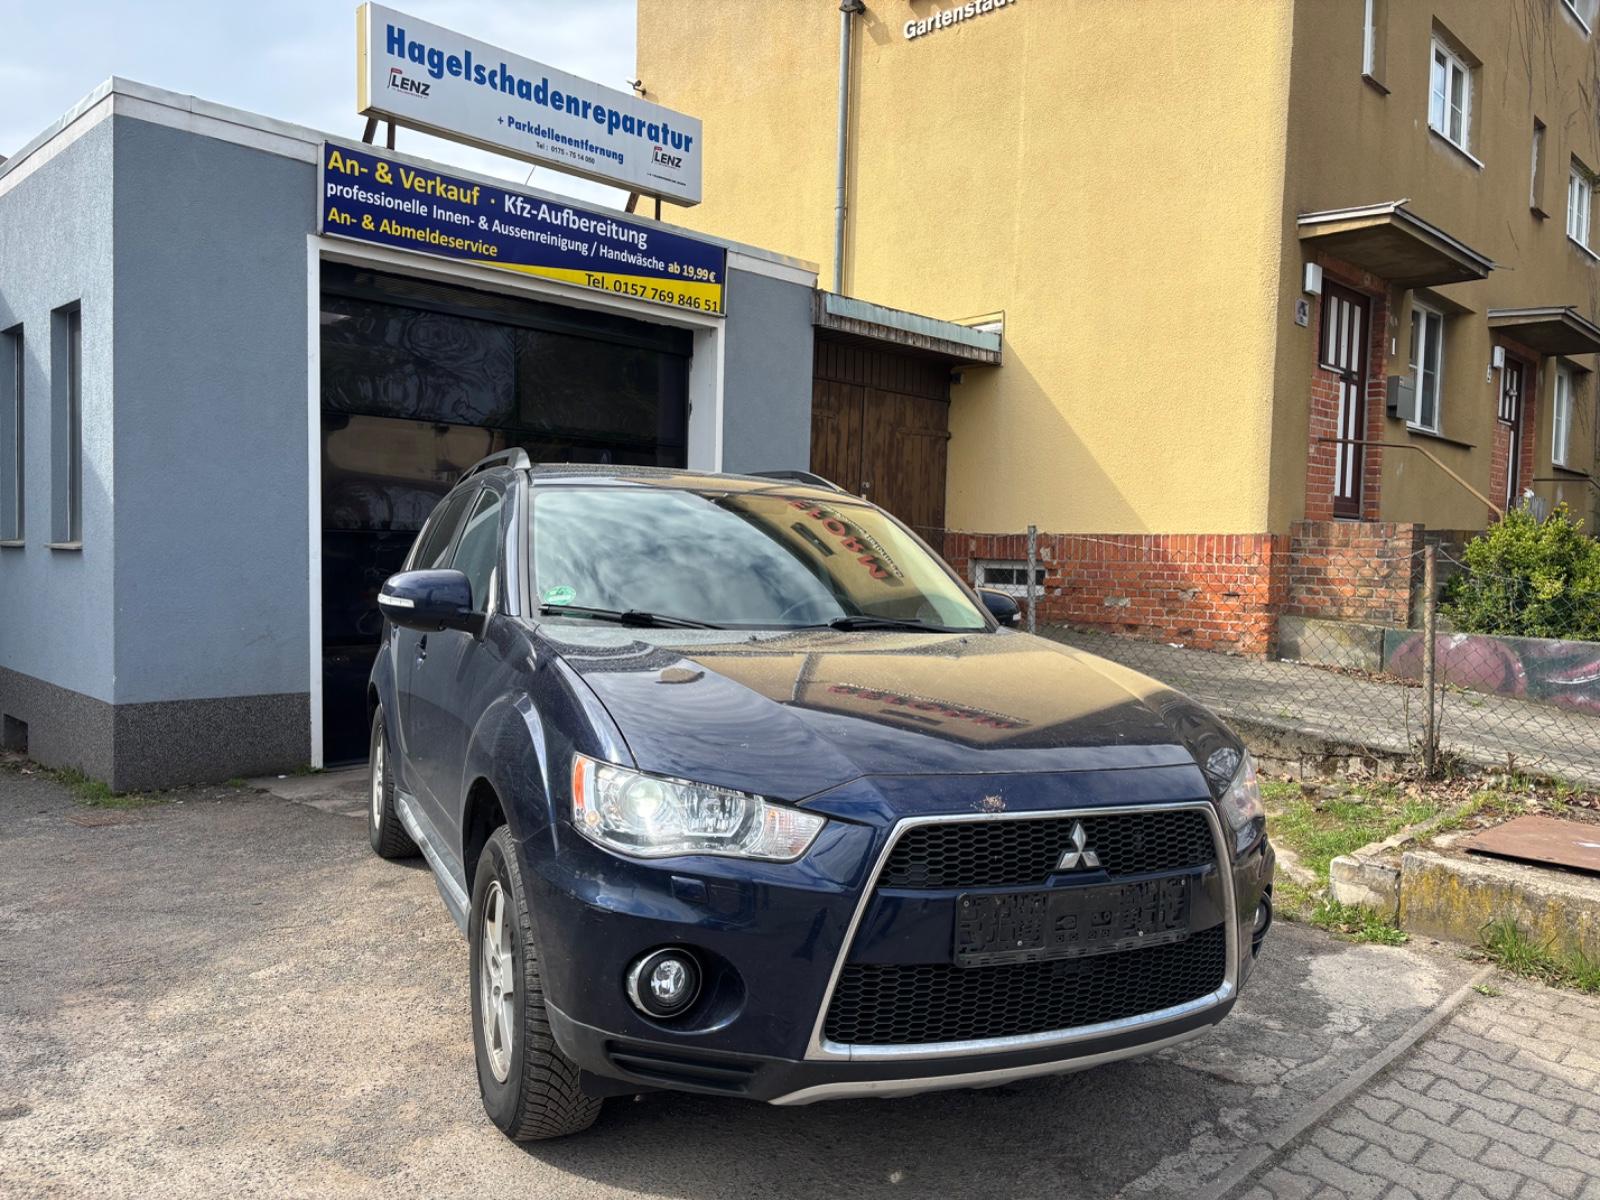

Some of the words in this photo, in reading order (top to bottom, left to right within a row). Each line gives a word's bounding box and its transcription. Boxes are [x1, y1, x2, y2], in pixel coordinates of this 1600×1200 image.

[903, 0, 1017, 39] Gartensta
[386, 24, 693, 153] Hagelschadenreparatur
[391, 74, 431, 96] LENZ
[507, 116, 624, 165] Parkdellenentfernung
[654, 151, 682, 168] LENZ
[328, 151, 369, 177] An-
[374, 162, 393, 185] &
[399, 168, 480, 206] Verkauf
[504, 194, 648, 250] Kfz-Aufbereitung
[327, 182, 428, 216] professionelle
[433, 204, 475, 226] Innen-
[478, 216, 489, 229] &
[492, 218, 588, 256] Aussenreinigung
[590, 241, 598, 257] /
[599, 244, 665, 271] Handwäsche
[667, 261, 681, 275] ab
[328, 207, 358, 226] An-
[361, 214, 375, 231] &
[379, 219, 498, 257] Abmeldeservice
[585, 273, 609, 290] Tel.
[613, 280, 646, 297] 0157
[651, 287, 674, 304] 769
[677, 293, 700, 309] 846
[704, 299, 718, 313] 51
